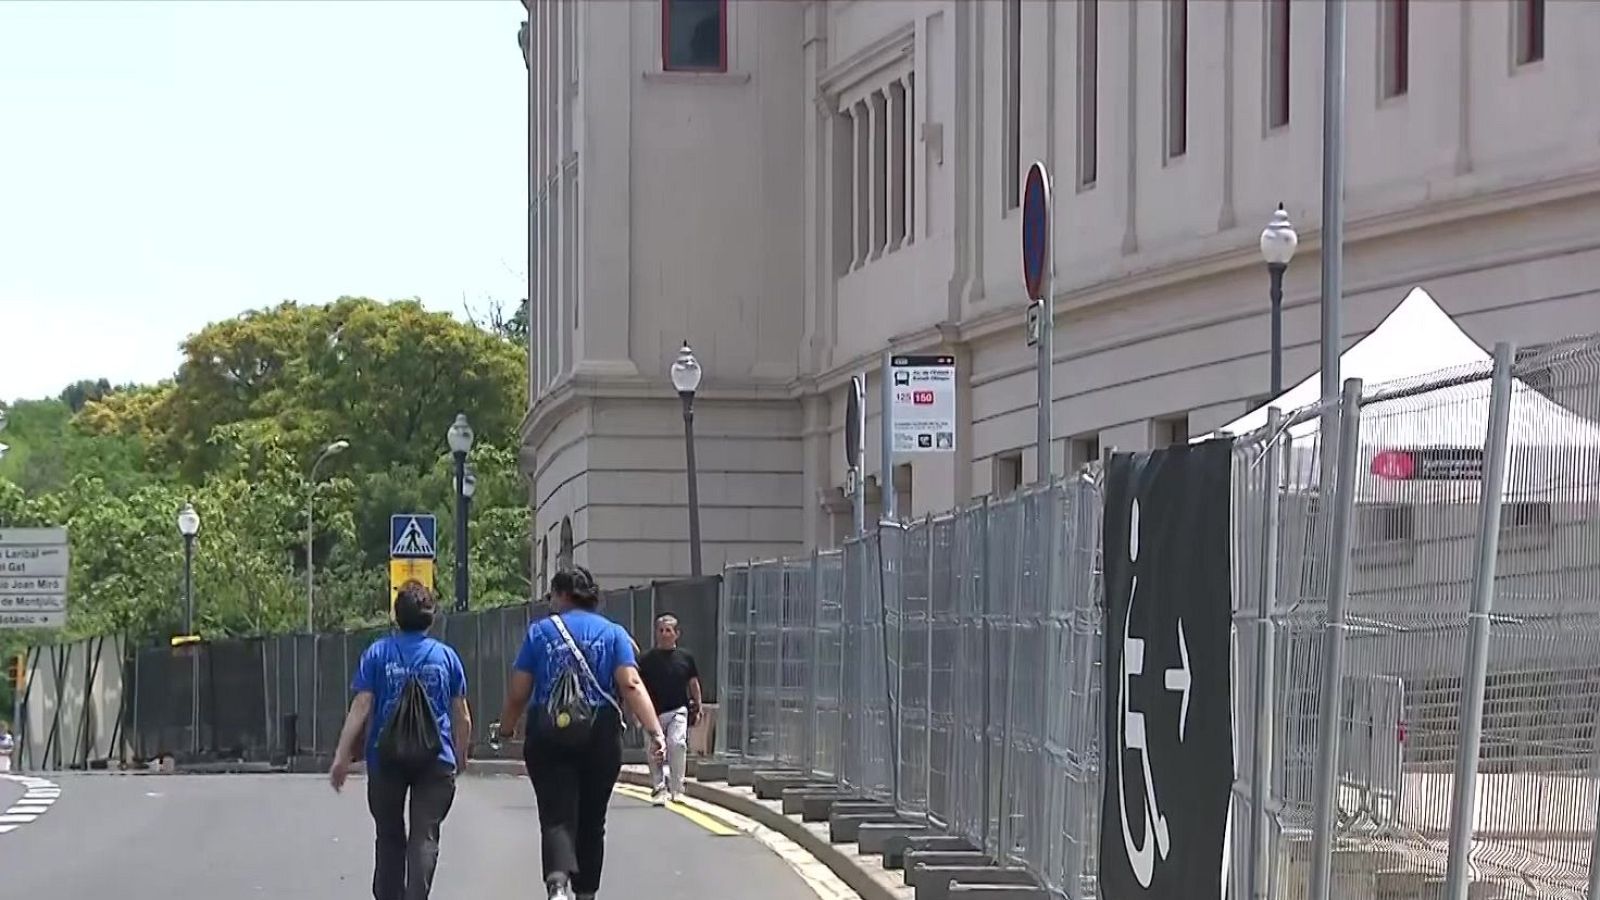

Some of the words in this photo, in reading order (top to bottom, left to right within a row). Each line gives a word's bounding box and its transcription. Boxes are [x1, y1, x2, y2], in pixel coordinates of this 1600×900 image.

[915, 393, 932, 402] 150
[11, 580, 35, 589] Joan
[1, 598, 13, 606] de
